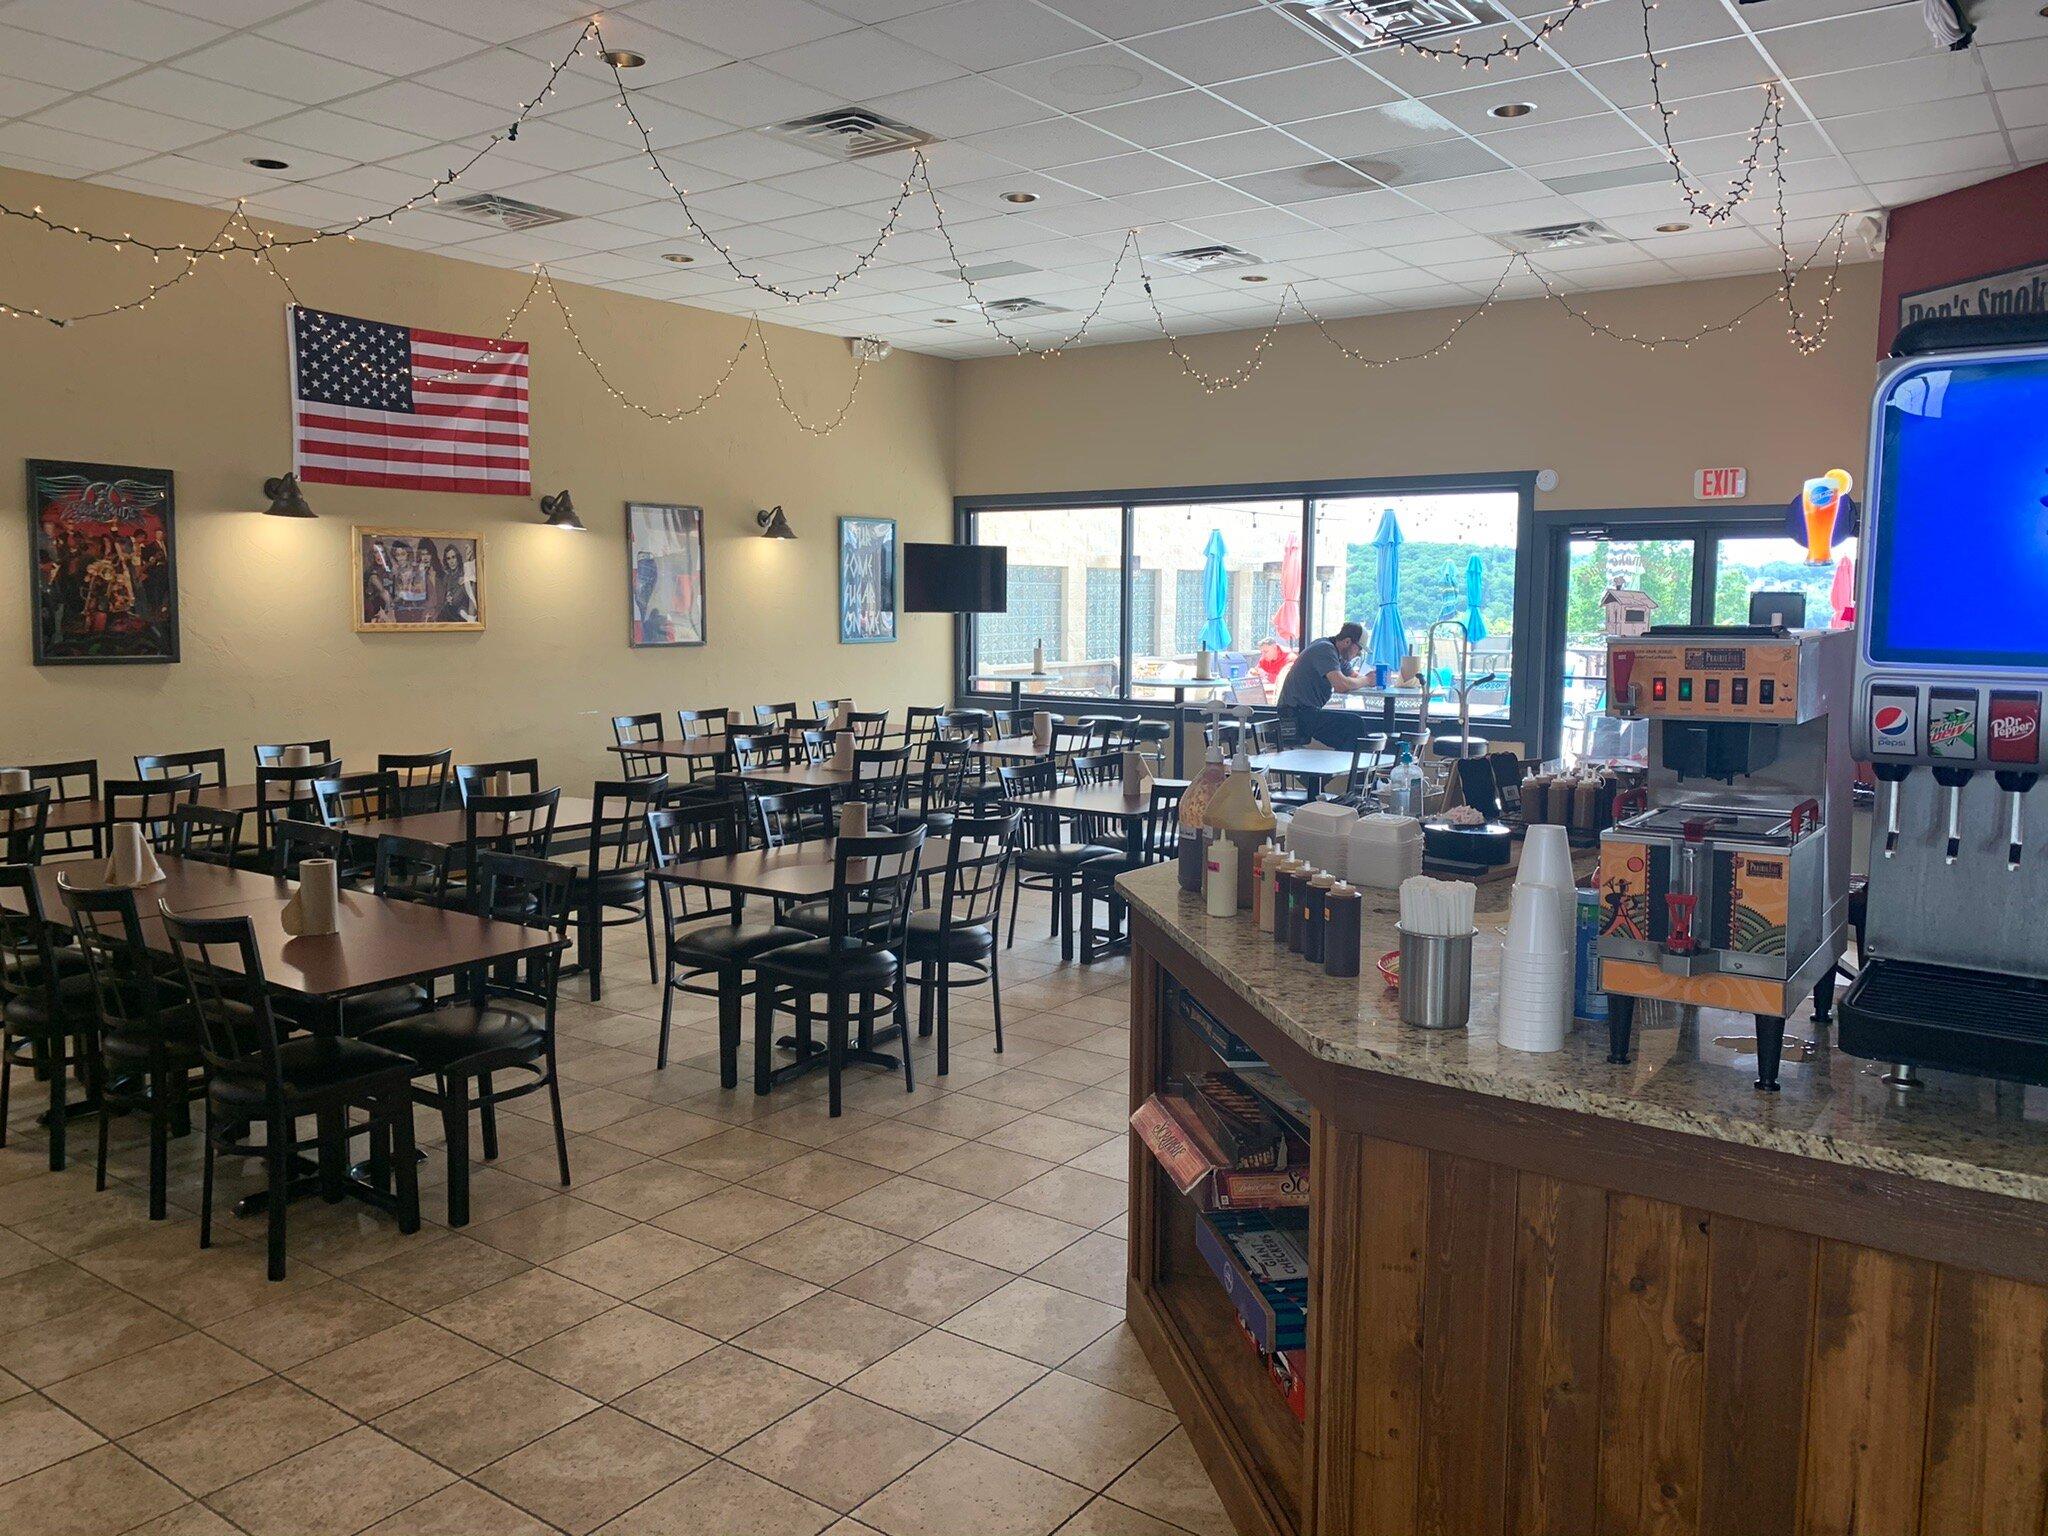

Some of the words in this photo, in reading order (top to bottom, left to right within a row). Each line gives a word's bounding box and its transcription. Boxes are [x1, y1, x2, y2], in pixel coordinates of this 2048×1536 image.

[1702, 469, 1739, 496] EXIT
[844, 552, 873, 578] SOME
[1990, 718, 2032, 738] Pepper
[2005, 716, 2022, 728] Dr
